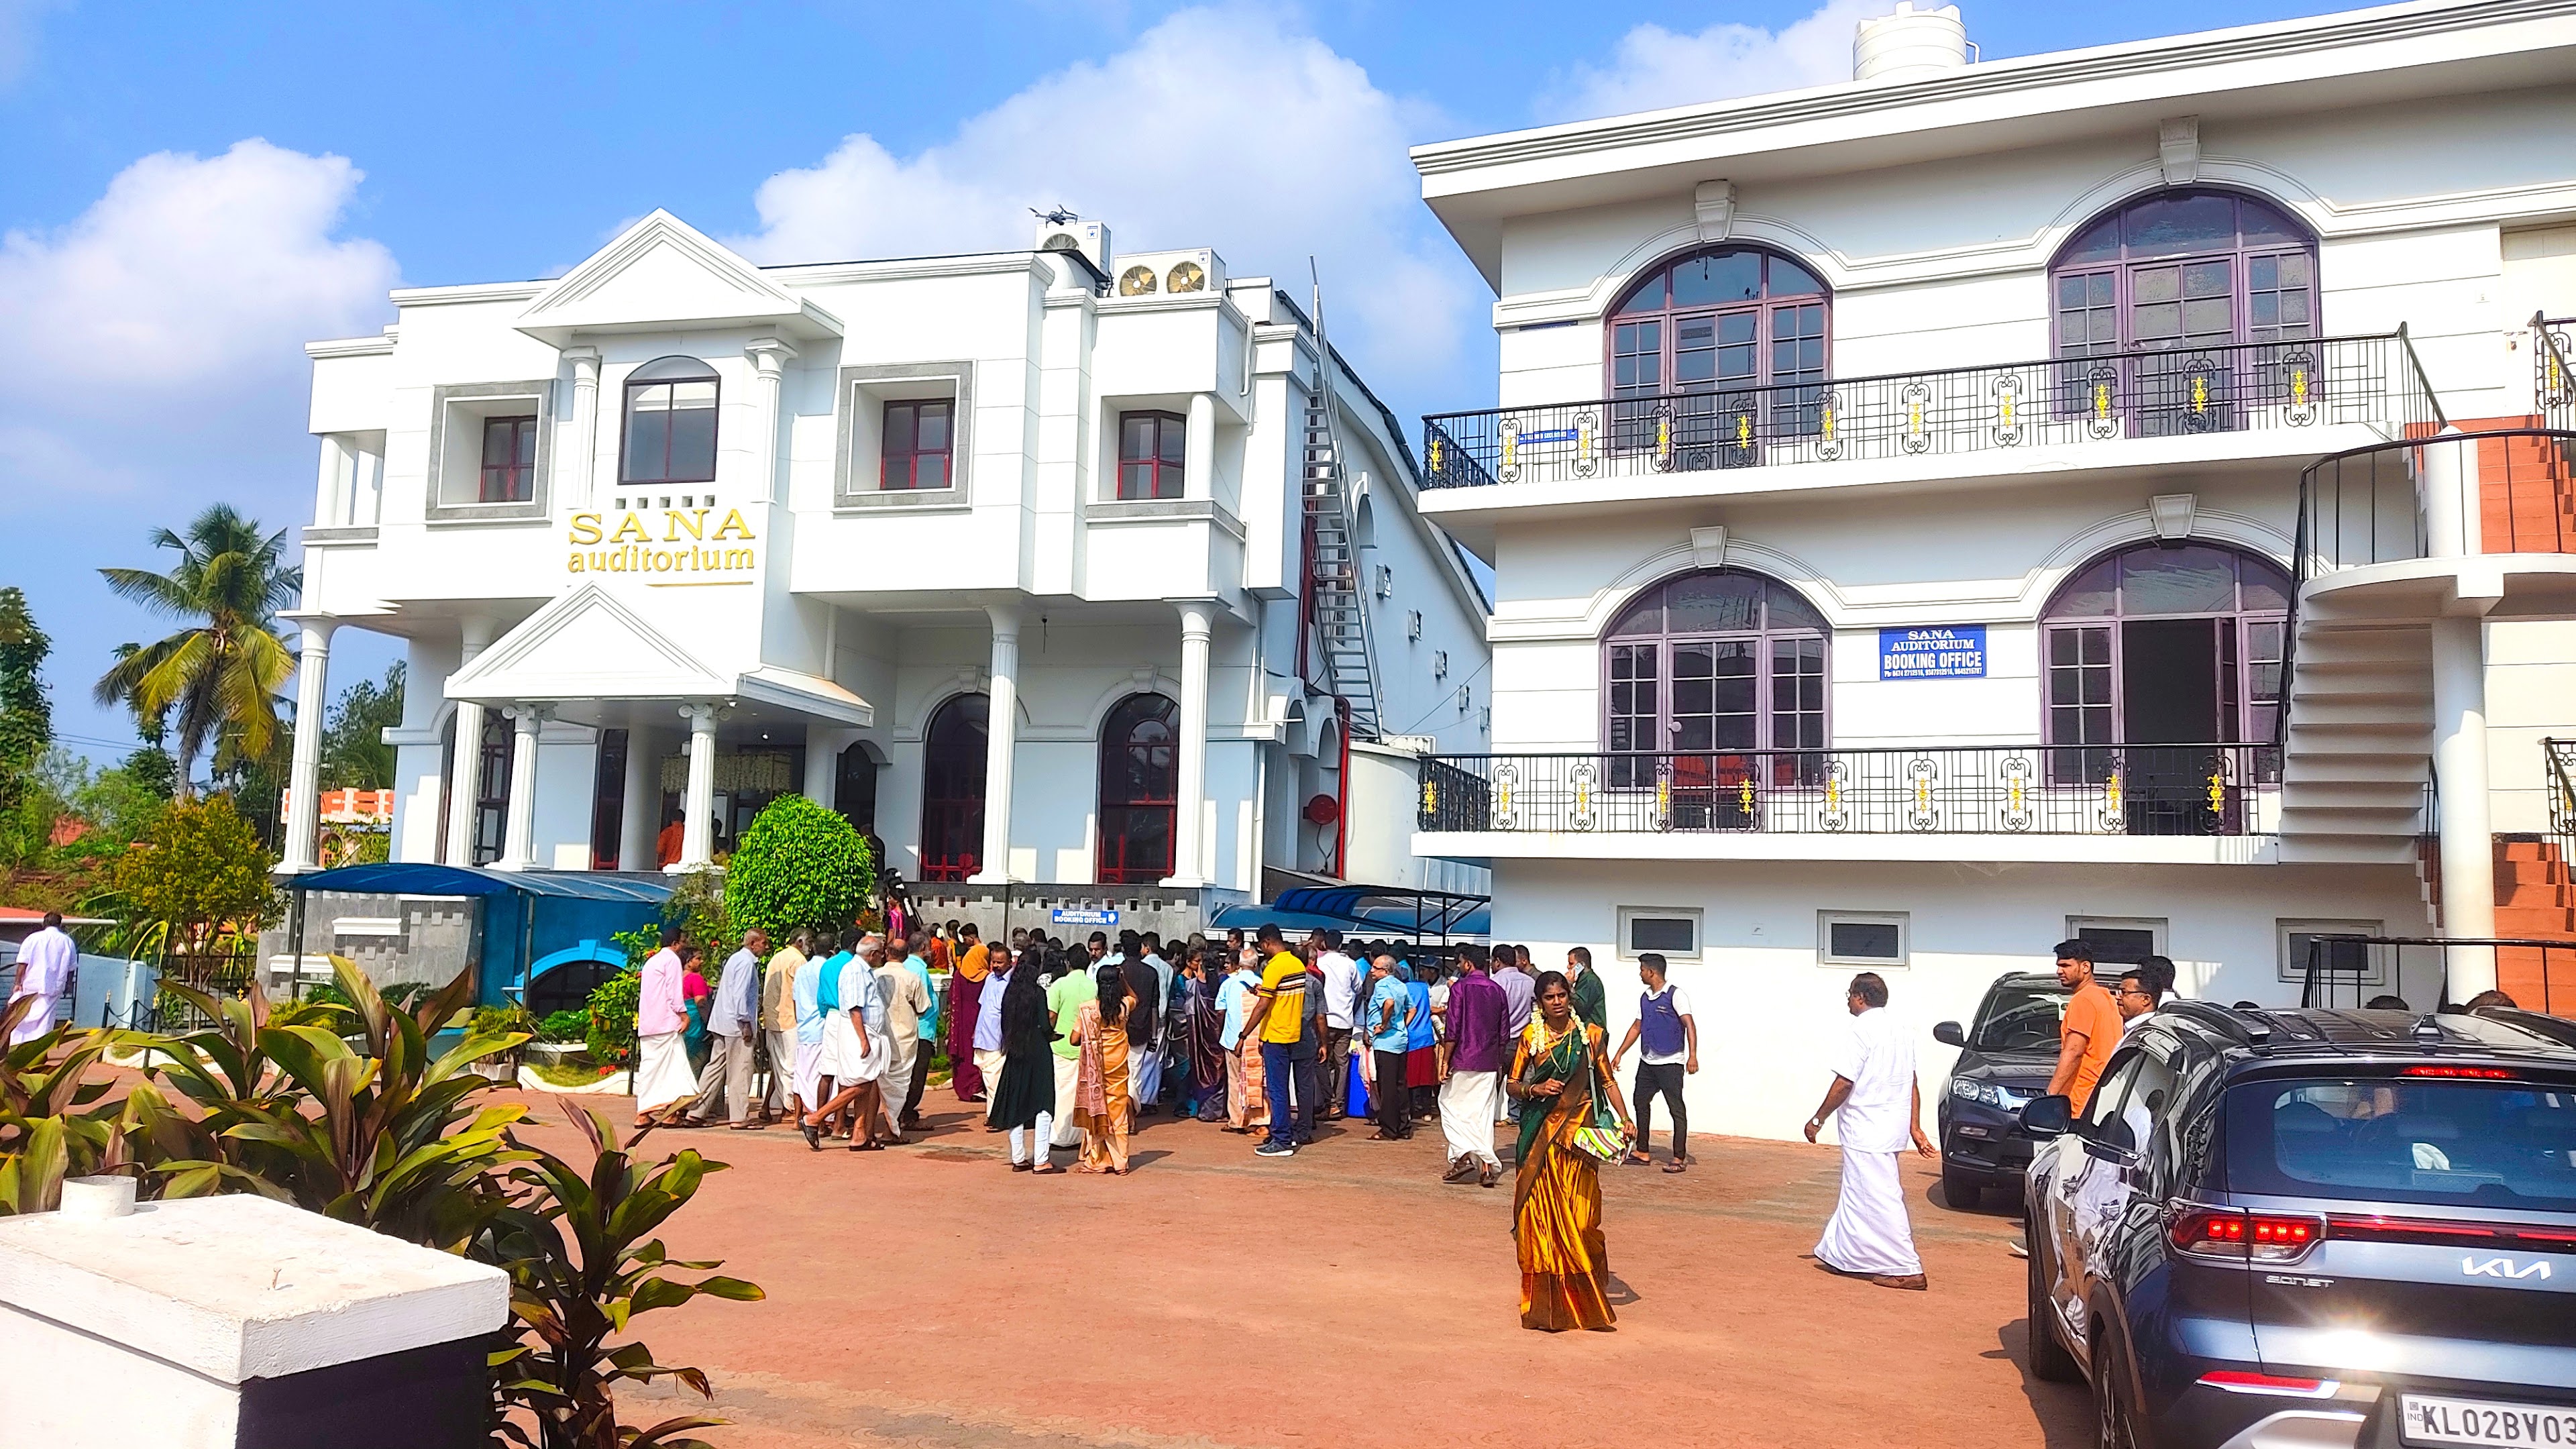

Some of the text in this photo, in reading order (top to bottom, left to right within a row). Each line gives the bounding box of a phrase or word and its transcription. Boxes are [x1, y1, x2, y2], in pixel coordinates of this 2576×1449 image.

[568, 508, 756, 545] SANA
[568, 545, 755, 573] auditorium
[1907, 629, 1955, 641] SANA
[1890, 639, 1975, 652] AUDITORIUM
[1884, 651, 1982, 670] BOOKING OFFICE
[2461, 1256, 2552, 1281] KIA
[2408, 1412, 2423, 1422] IND
